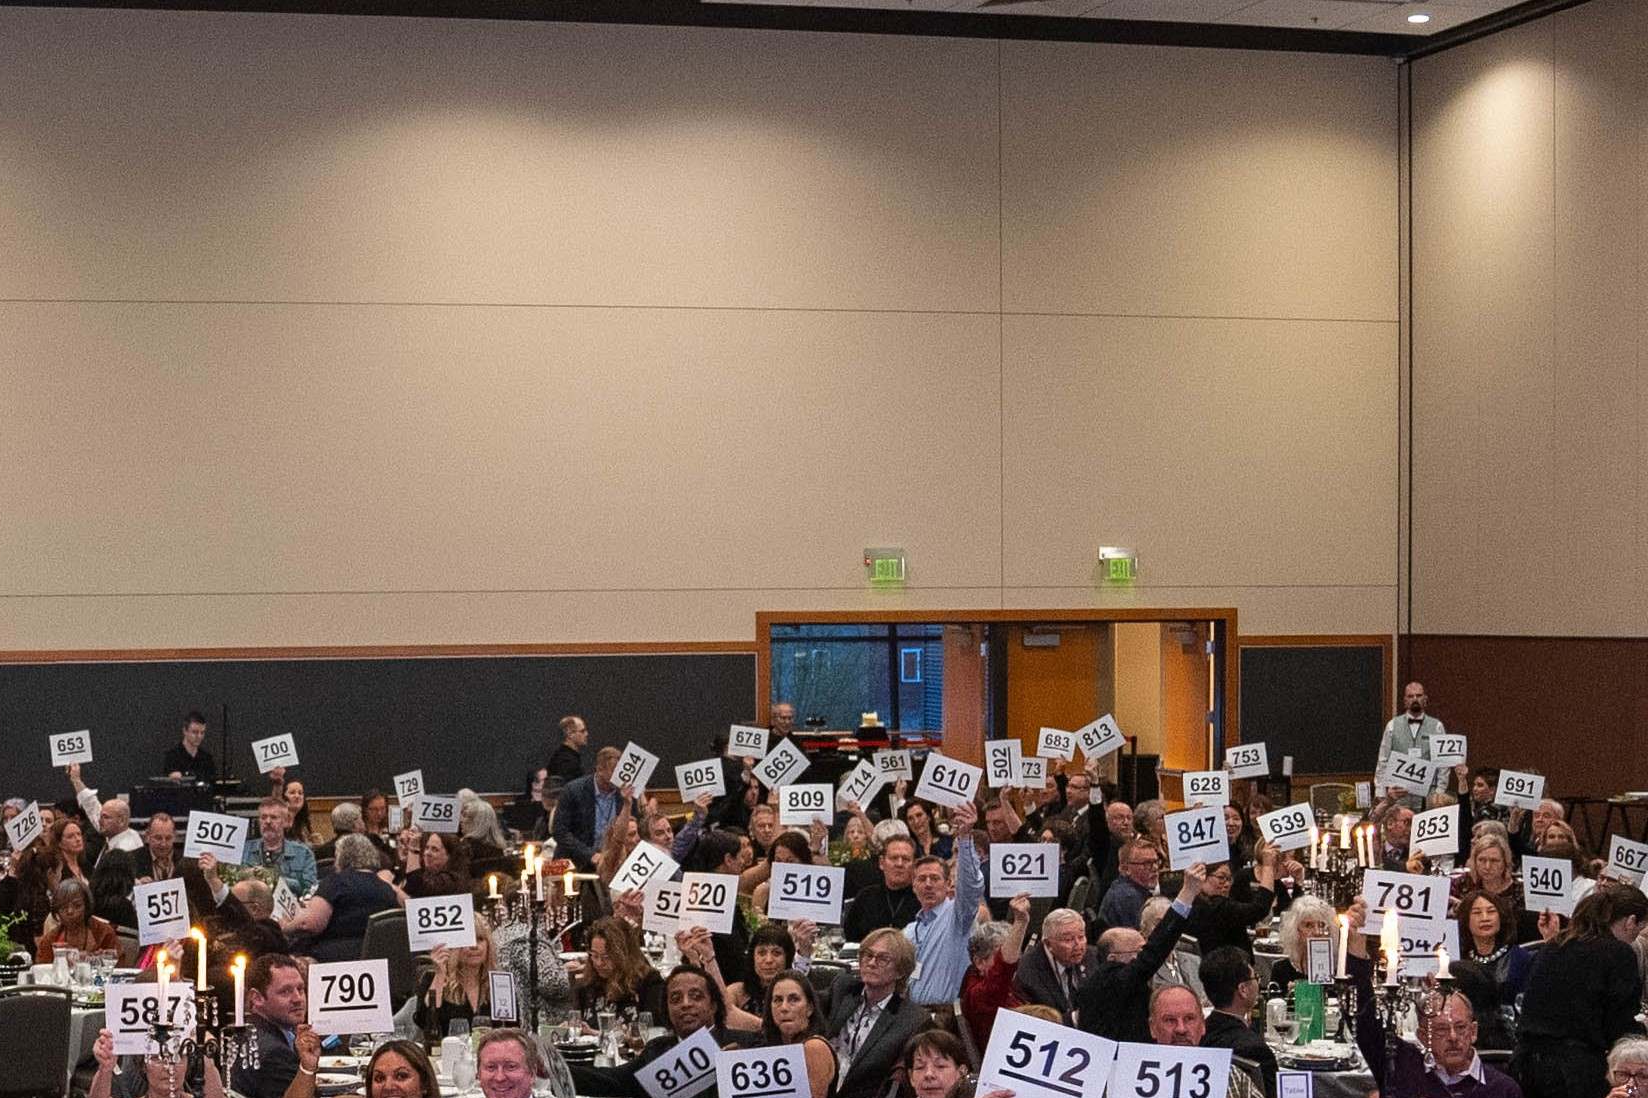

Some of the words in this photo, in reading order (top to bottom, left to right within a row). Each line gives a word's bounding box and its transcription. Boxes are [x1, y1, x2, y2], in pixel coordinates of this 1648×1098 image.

[57, 737, 84, 752] 653
[736, 731, 761, 745] 678
[1045, 734, 1070, 748] 683
[1083, 723, 1111, 746] 813
[261, 741, 288, 758] 700
[1232, 749, 1260, 764] 753
[1437, 740, 1462, 753] 727
[621, 753, 641, 782] 694
[765, 750, 793, 779] 663
[881, 755, 905, 769] 561
[992, 748, 1008, 778] 502
[1396, 759, 1427, 780] 744
[400, 778, 418, 792] 729
[684, 767, 715, 785] 605
[847, 770, 871, 796] 714
[933, 765, 970, 791] 610
[1191, 777, 1221, 791] 628
[1506, 777, 1534, 794] 691
[422, 802, 453, 818] 758
[789, 791, 824, 807] 809
[13, 811, 36, 837] 726
[197, 821, 237, 843] 507
[1178, 816, 1215, 844] 847
[1270, 812, 1305, 833] 639
[1417, 815, 1449, 837] 853
[1002, 853, 1044, 874] 621
[1616, 846, 1648, 868] 667
[622, 852, 654, 889] 787
[1530, 867, 1562, 891] 540
[688, 883, 726, 907] 520
[783, 873, 831, 898] 519
[148, 890, 179, 918] 557
[656, 890, 681, 913] 57
[1379, 882, 1431, 914] 781
[418, 905, 463, 928] 852
[321, 973, 374, 1003] 790
[121, 997, 180, 1025] 587
[655, 1047, 710, 1090] 810
[1006, 1031, 1090, 1087] 512
[732, 1058, 792, 1091] 636
